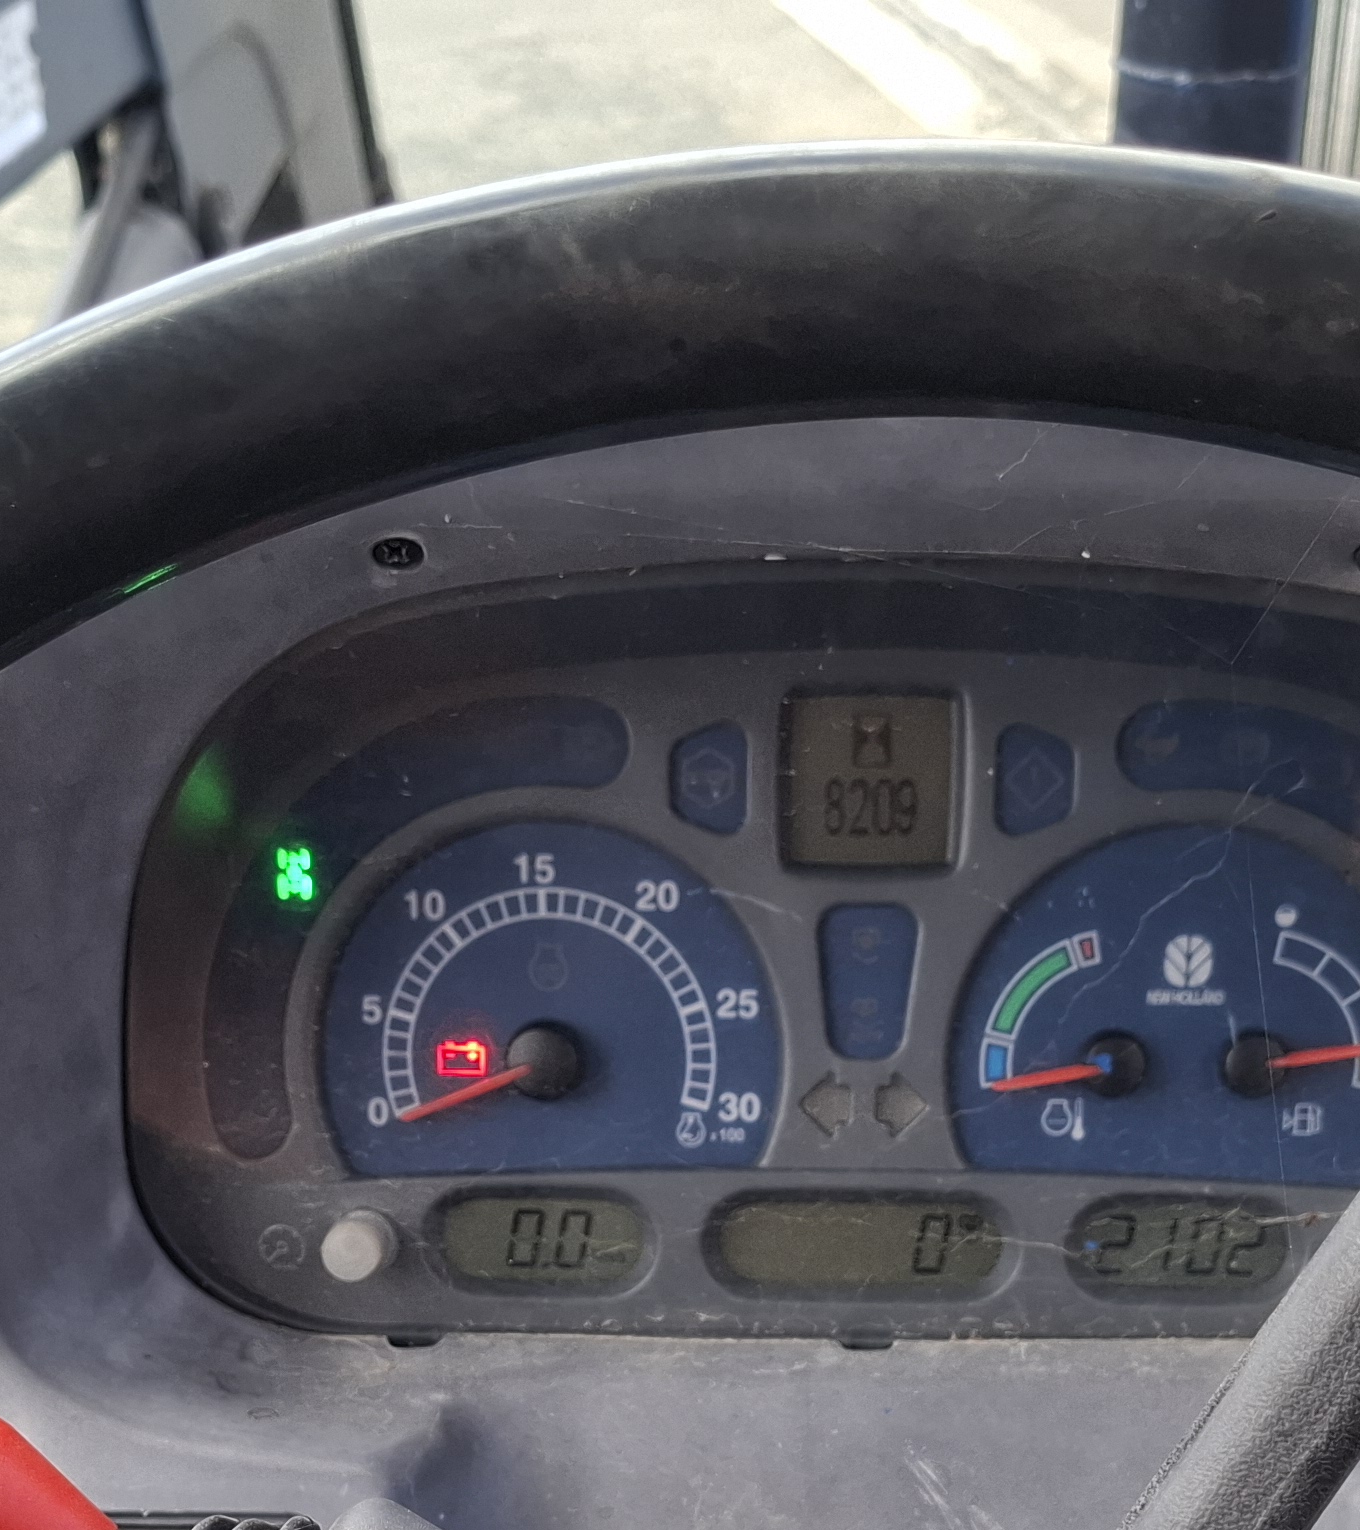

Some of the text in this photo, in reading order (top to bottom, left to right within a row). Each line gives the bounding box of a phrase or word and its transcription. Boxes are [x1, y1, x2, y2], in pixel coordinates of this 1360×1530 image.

[824, 778, 918, 836] 8209
[514, 854, 556, 882] 15
[405, 892, 446, 919] 10
[636, 881, 680, 911] 20
[361, 995, 382, 1025] 5
[717, 989, 759, 1018] 25
[367, 1098, 390, 1128] 0
[717, 1092, 761, 1123] 30
